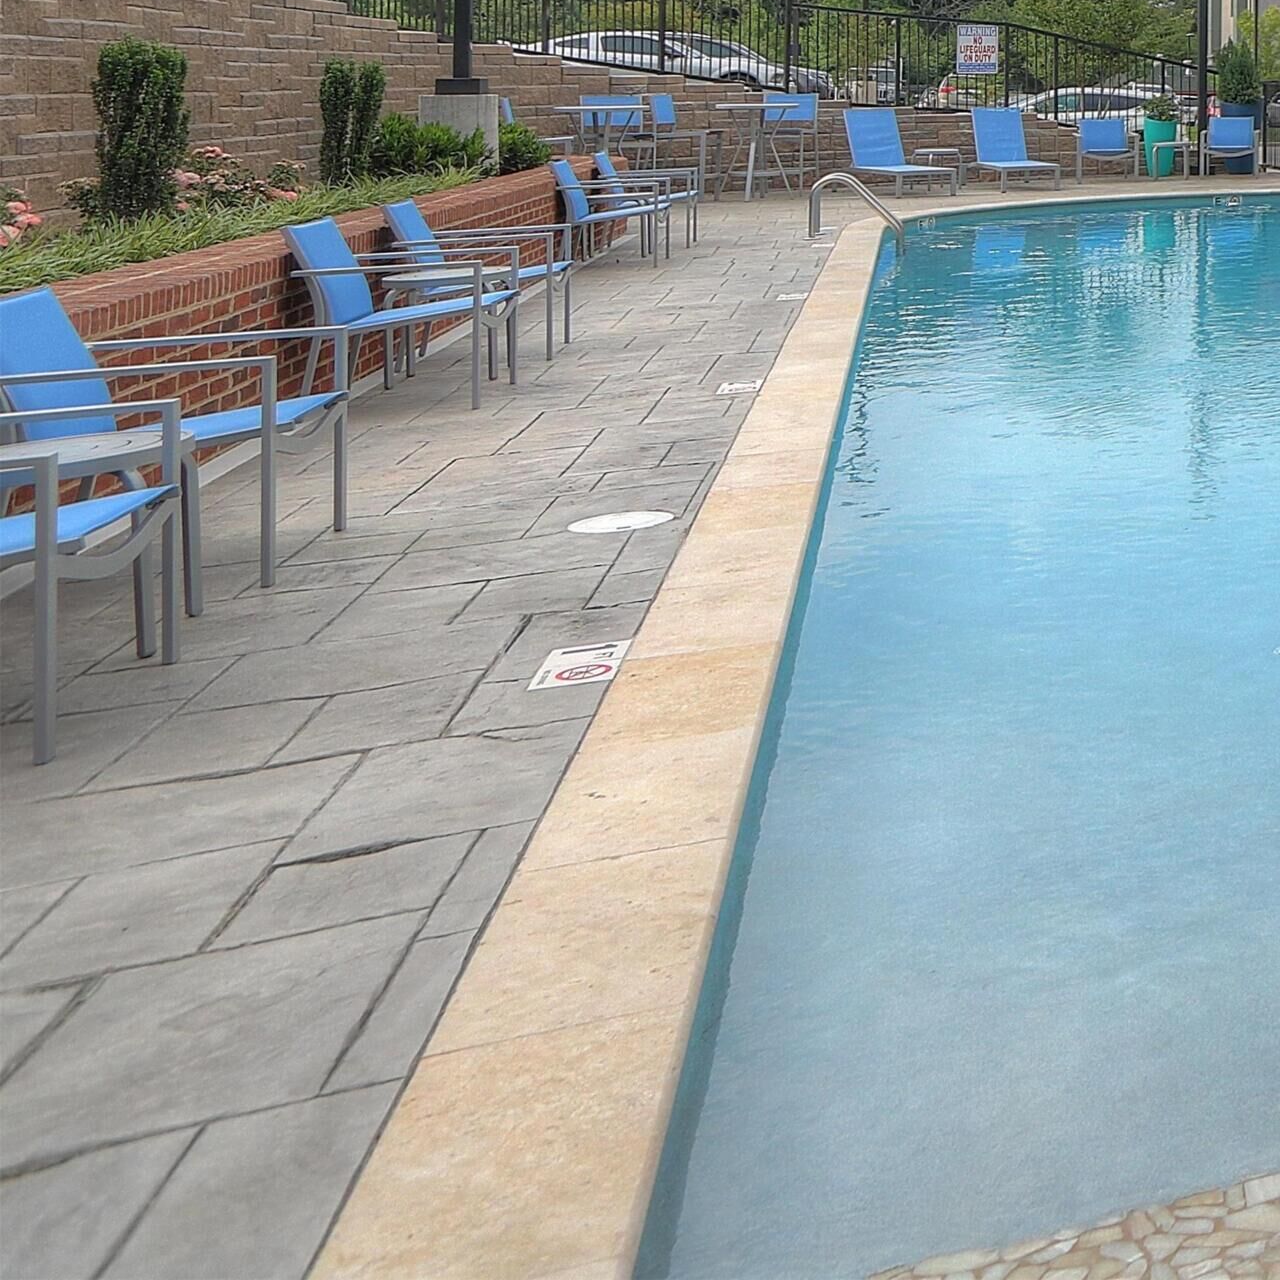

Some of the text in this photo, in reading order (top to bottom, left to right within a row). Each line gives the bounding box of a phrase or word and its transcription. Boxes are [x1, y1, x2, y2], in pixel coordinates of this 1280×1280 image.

[960, 27, 996, 36] WARNING
[973, 36, 983, 45] NO
[960, 45, 996, 54] LIFEGUARD
[964, 54, 992, 63] ON DUTY
[561, 644, 619, 655] 1
